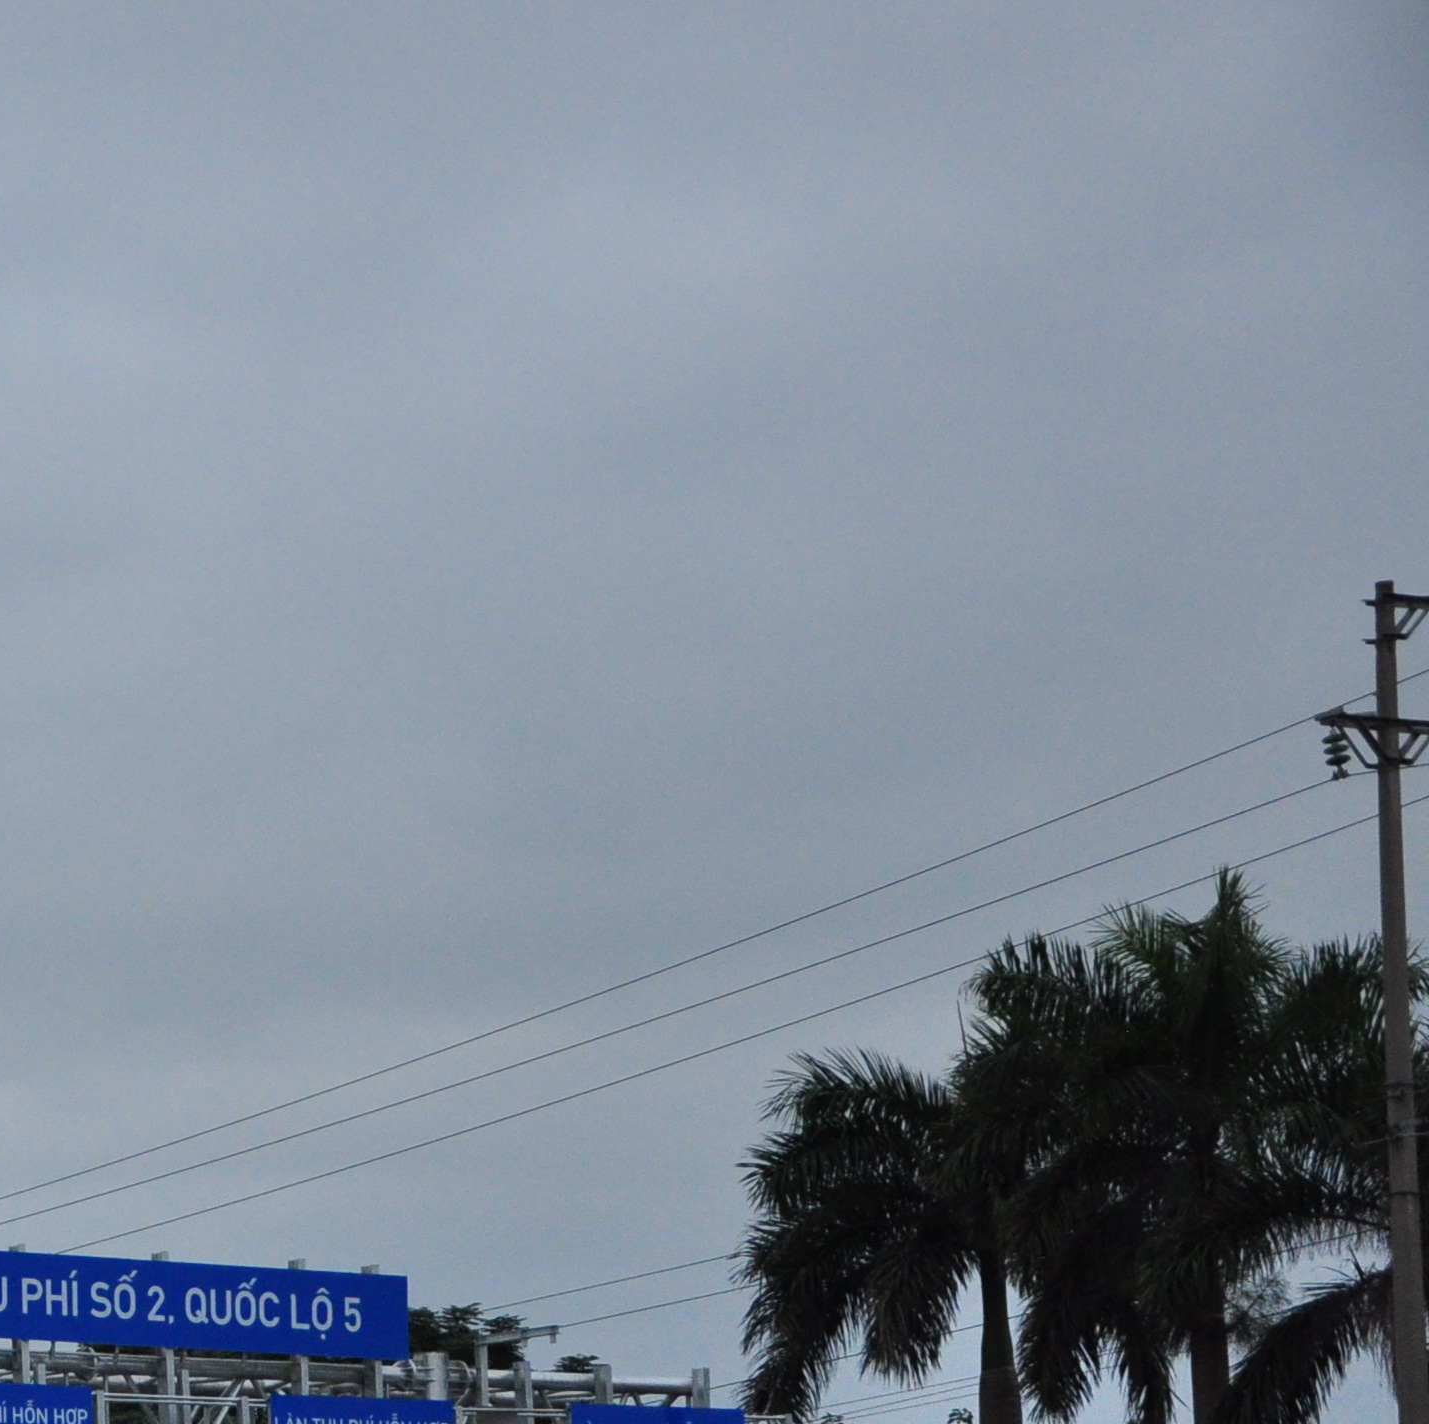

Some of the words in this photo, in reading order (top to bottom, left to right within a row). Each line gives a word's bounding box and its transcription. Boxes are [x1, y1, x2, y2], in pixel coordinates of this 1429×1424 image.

[22, 1270, 80, 1317] PHÍ
[90, 1269, 138, 1320] SỐ
[184, 1278, 280, 1328] QUỐC
[290, 1288, 334, 1341] LỘ
[344, 1297, 362, 1332] 5
[12, 1400, 48, 1424] HỖN
